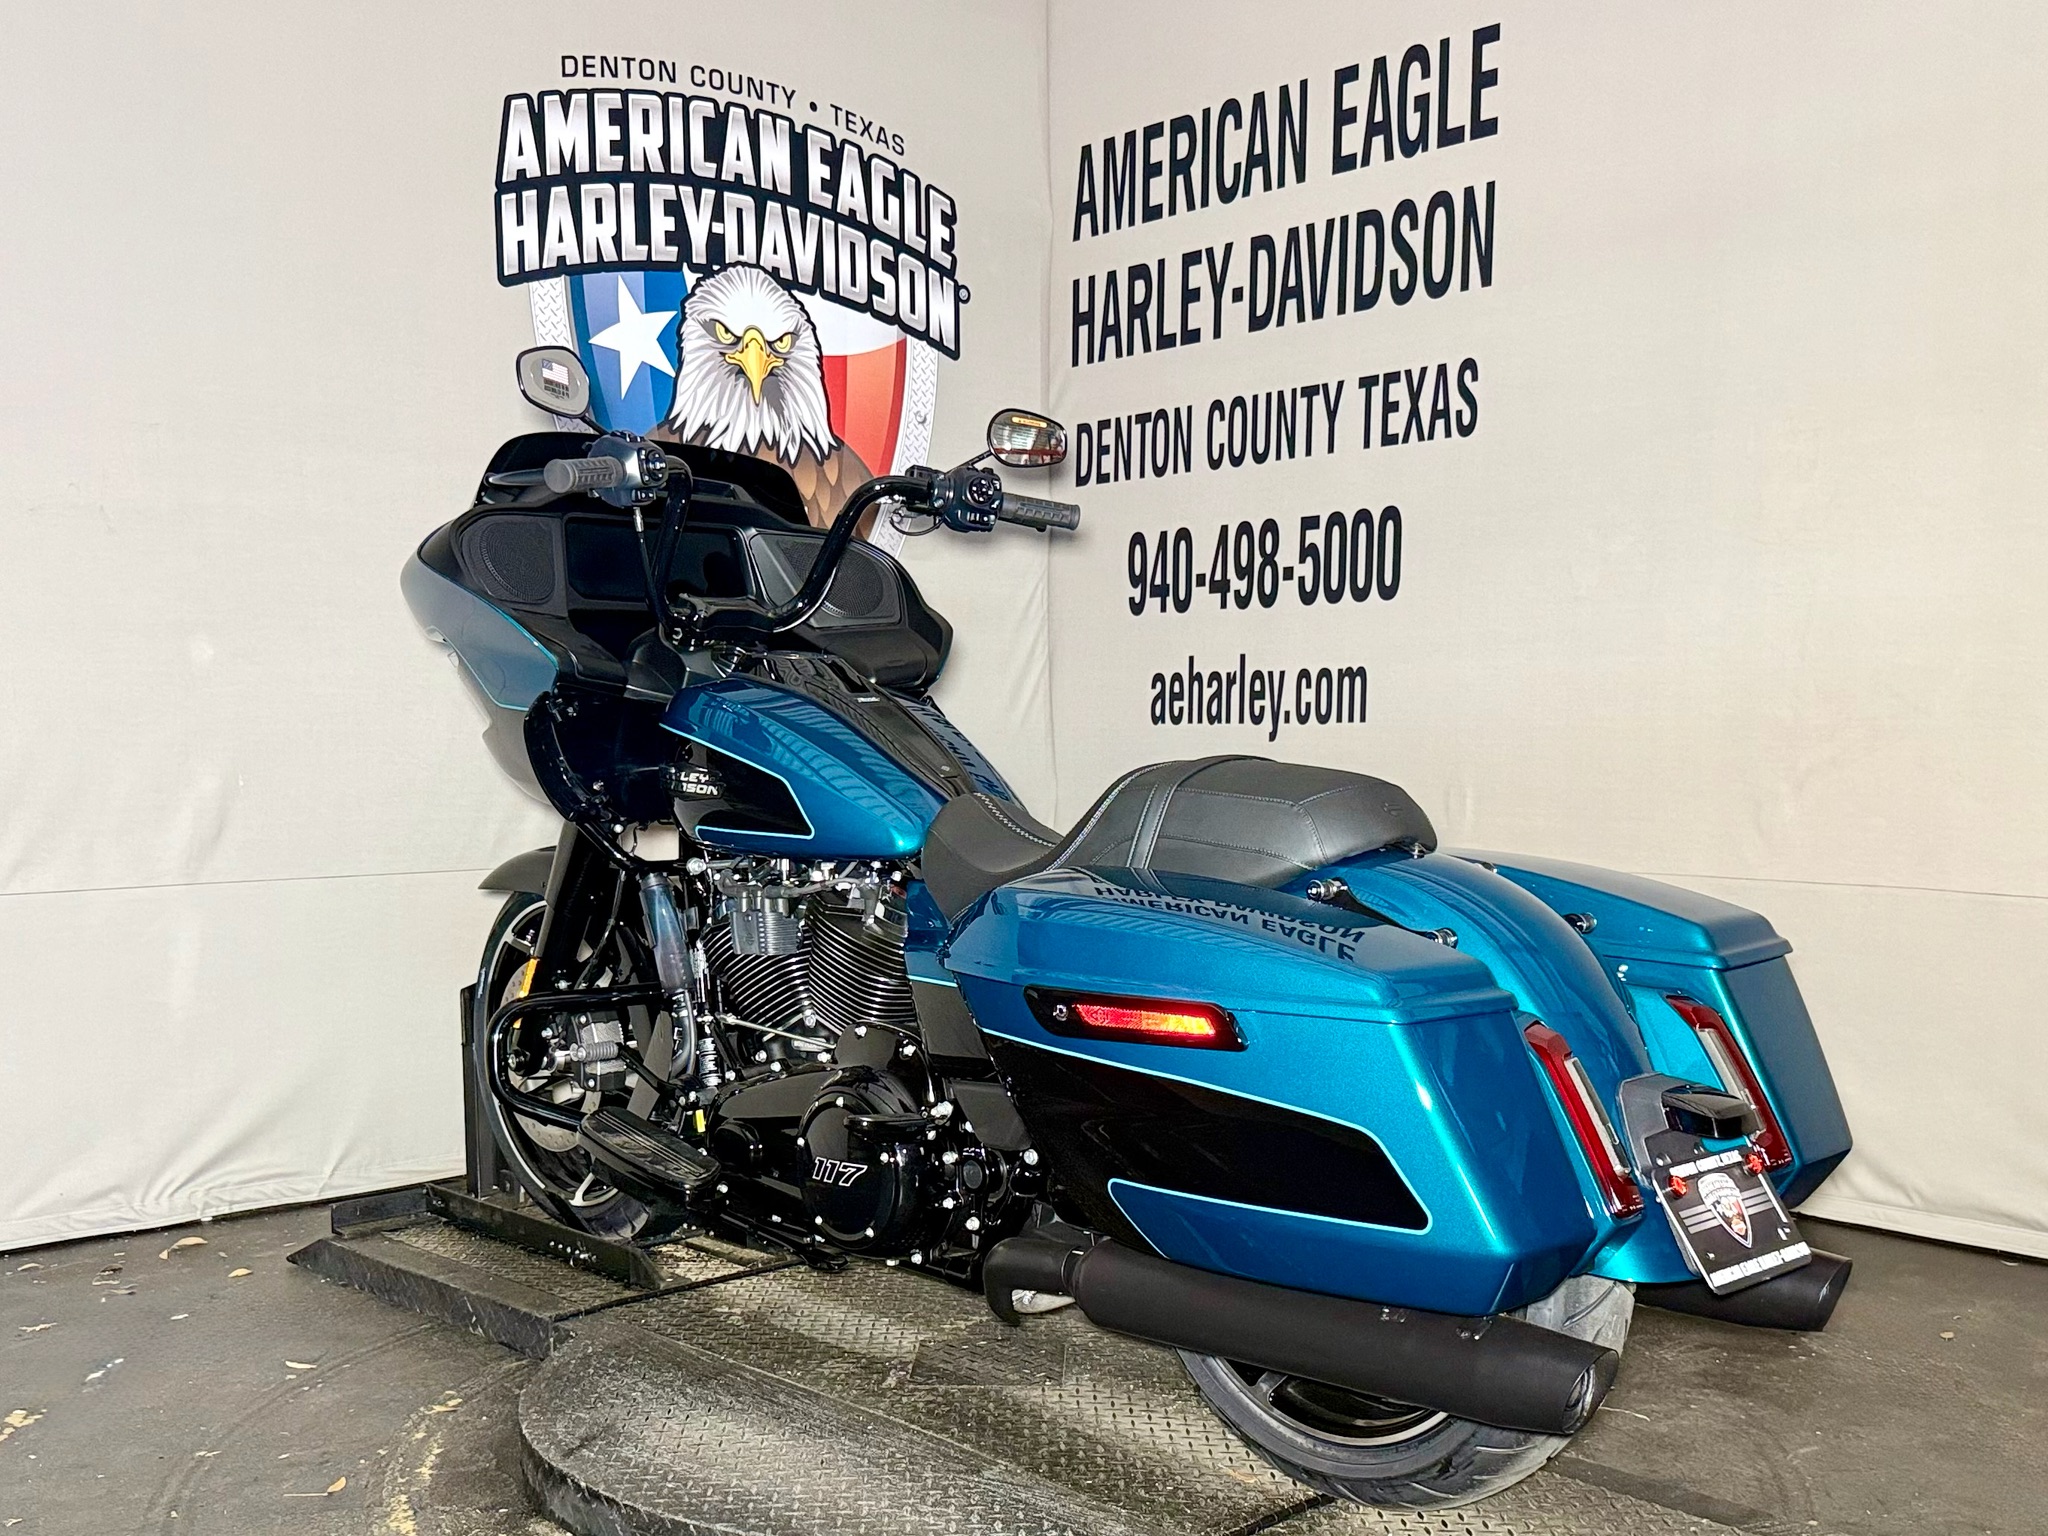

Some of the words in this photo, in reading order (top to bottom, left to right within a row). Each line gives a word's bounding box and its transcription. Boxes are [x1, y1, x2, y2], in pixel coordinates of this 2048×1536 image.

[560, 54, 677, 83] DENTON
[689, 64, 797, 110] COUNTY
[829, 102, 906, 157] TEXAS
[1072, 78, 1309, 242] AMERICAN
[1331, 22, 1501, 176] EAGLE
[500, 91, 795, 196] AMERICAN
[806, 127, 954, 270] EAGLE
[500, 182, 959, 353] HARLEY-DAVIDSON
[1070, 180, 1497, 369] HARLEY-DAVIDSON
[1074, 404, 1193, 488] DENTON
[1206, 380, 1345, 471] COUNTY
[1357, 357, 1480, 450] TEXAS
[1127, 504, 1403, 617] 940-498-5000
[1150, 653, 1368, 743] aeharley.com
[679, 771, 710, 784] LEY
[811, 1156, 869, 1188] 117
